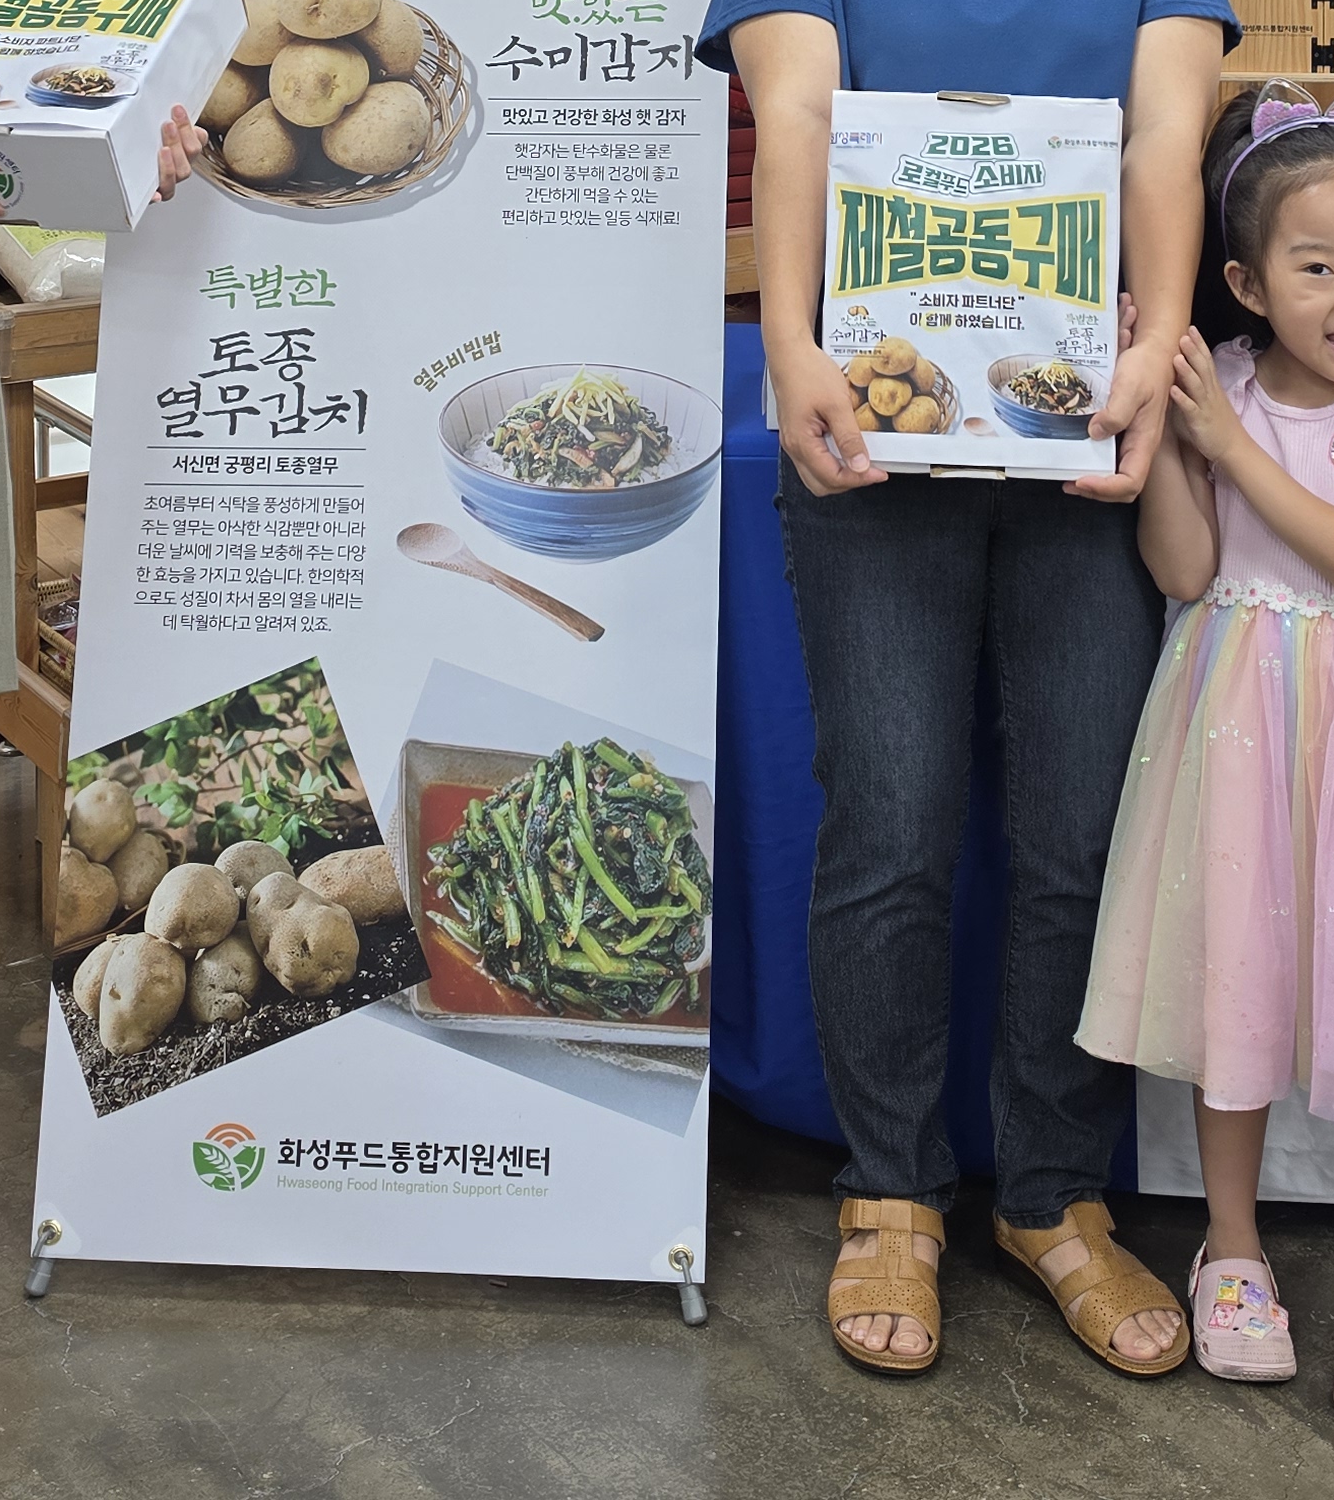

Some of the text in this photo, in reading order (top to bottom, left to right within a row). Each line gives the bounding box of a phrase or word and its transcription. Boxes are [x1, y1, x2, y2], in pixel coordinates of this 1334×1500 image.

[485, 33, 695, 82] 수미감자
[502, 108, 686, 126] 맛있고 건강한 화성 햇 감자
[515, 143, 672, 159] 햇감자는 탄수화물은 물론
[925, 134, 1015, 156] 2026
[505, 166, 679, 181] 단백질이 풍부해 건강에 좋고
[897, 159, 1044, 195] 로컬푸드 소비자
[525, 188, 659, 204] 간단하게 먹을 수 있는
[502, 209, 680, 226] 편리하고 맛있는 일등 식재료!
[838, 189, 1100, 304] 제철공동구매
[199, 264, 338, 310] 특별한
[909, 312, 1026, 331] 이 함께 하였습니다.
[198, 327, 317, 382] 토종
[413, 330, 502, 392] 열무비빔밥
[156, 381, 368, 439] 열무김치
[172, 455, 339, 475] 서신면 궁평리 토종열무
[143, 495, 365, 514] 초여름부터 식탁을 풍성하게 만들어
[140, 519, 366, 537] 주는 열무는 아삭한 식감뿐만 아니라
[138, 543, 366, 562] 더운 날씨에 기력을 보충해 주는 다양
[136, 566, 364, 585] 한 효능을 가지고 있습니다. 한의학적
[134, 590, 364, 609] 으로도 성질이 차서 몸의 열을 내리는
[163, 615, 332, 632] 데 탁월하다고 알려져 있죠.
[278, 1138, 550, 1177] 화성푸드통합지원센터
[276, 1175, 549, 1198] Hwaseong Food Integration Support Center
